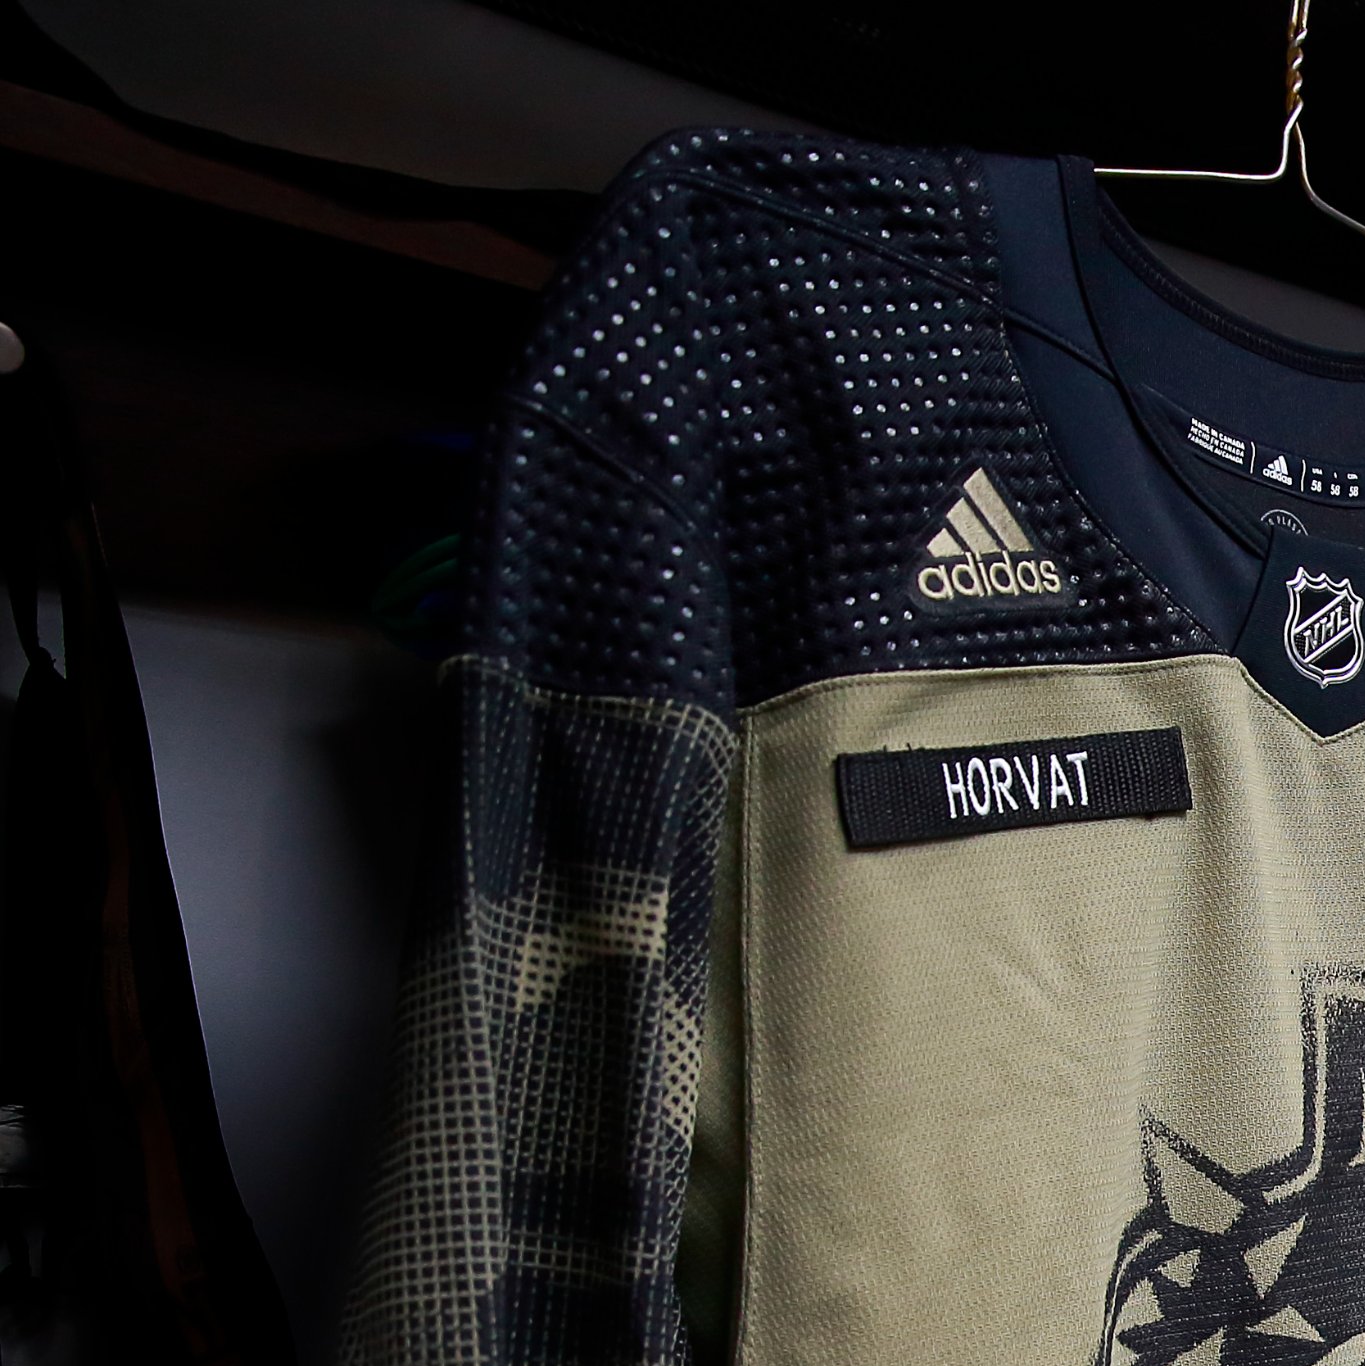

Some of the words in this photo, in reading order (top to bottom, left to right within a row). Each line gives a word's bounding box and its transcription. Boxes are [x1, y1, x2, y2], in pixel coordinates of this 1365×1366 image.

[1190, 425, 1210, 441] HECHO
[1219, 442, 1246, 458] CANADA
[1191, 417, 1211, 434] MADE
[1211, 428, 1219, 438] IN
[1219, 432, 1246, 451] CANADA
[1222, 450, 1244, 465] CANADA
[1262, 467, 1293, 486] adidas
[1310, 479, 1322, 492] 58
[1330, 483, 1341, 497] 58
[1348, 485, 1359, 498] 58
[918, 550, 1062, 601] adidas
[1303, 605, 1349, 657] NHL
[942, 750, 1089, 819] HORVAT
